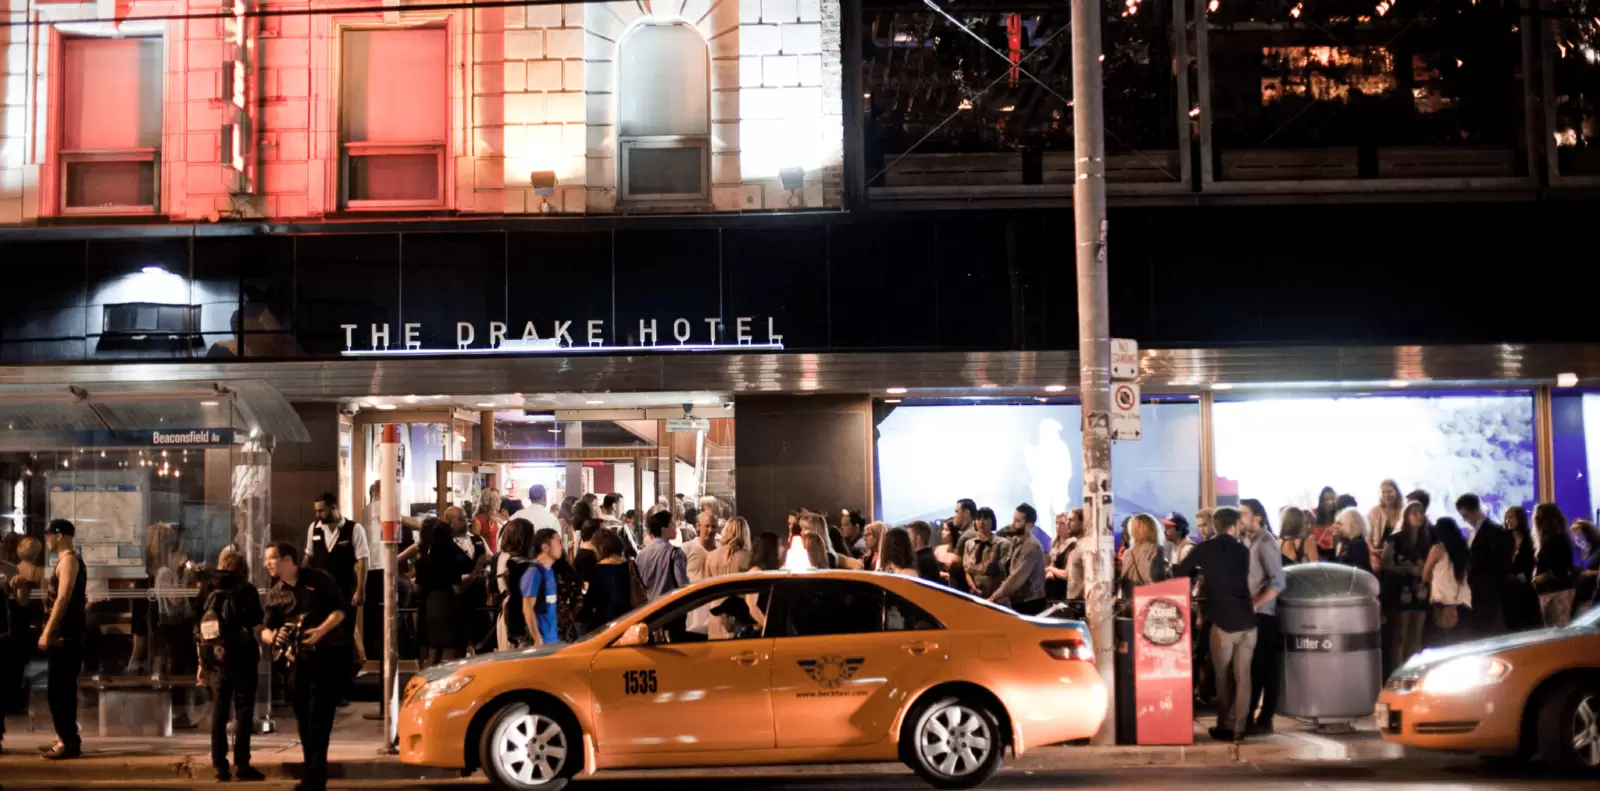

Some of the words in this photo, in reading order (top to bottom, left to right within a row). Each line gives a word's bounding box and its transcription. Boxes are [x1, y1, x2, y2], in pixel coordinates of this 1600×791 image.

[340, 323, 421, 347] THE
[456, 319, 604, 345] DRAKE
[639, 317, 784, 346] HOTEL
[153, 431, 209, 444] Beaconsfield
[211, 433, 221, 442] Av
[1295, 637, 1319, 649] Litter
[623, 670, 658, 695] 1535
